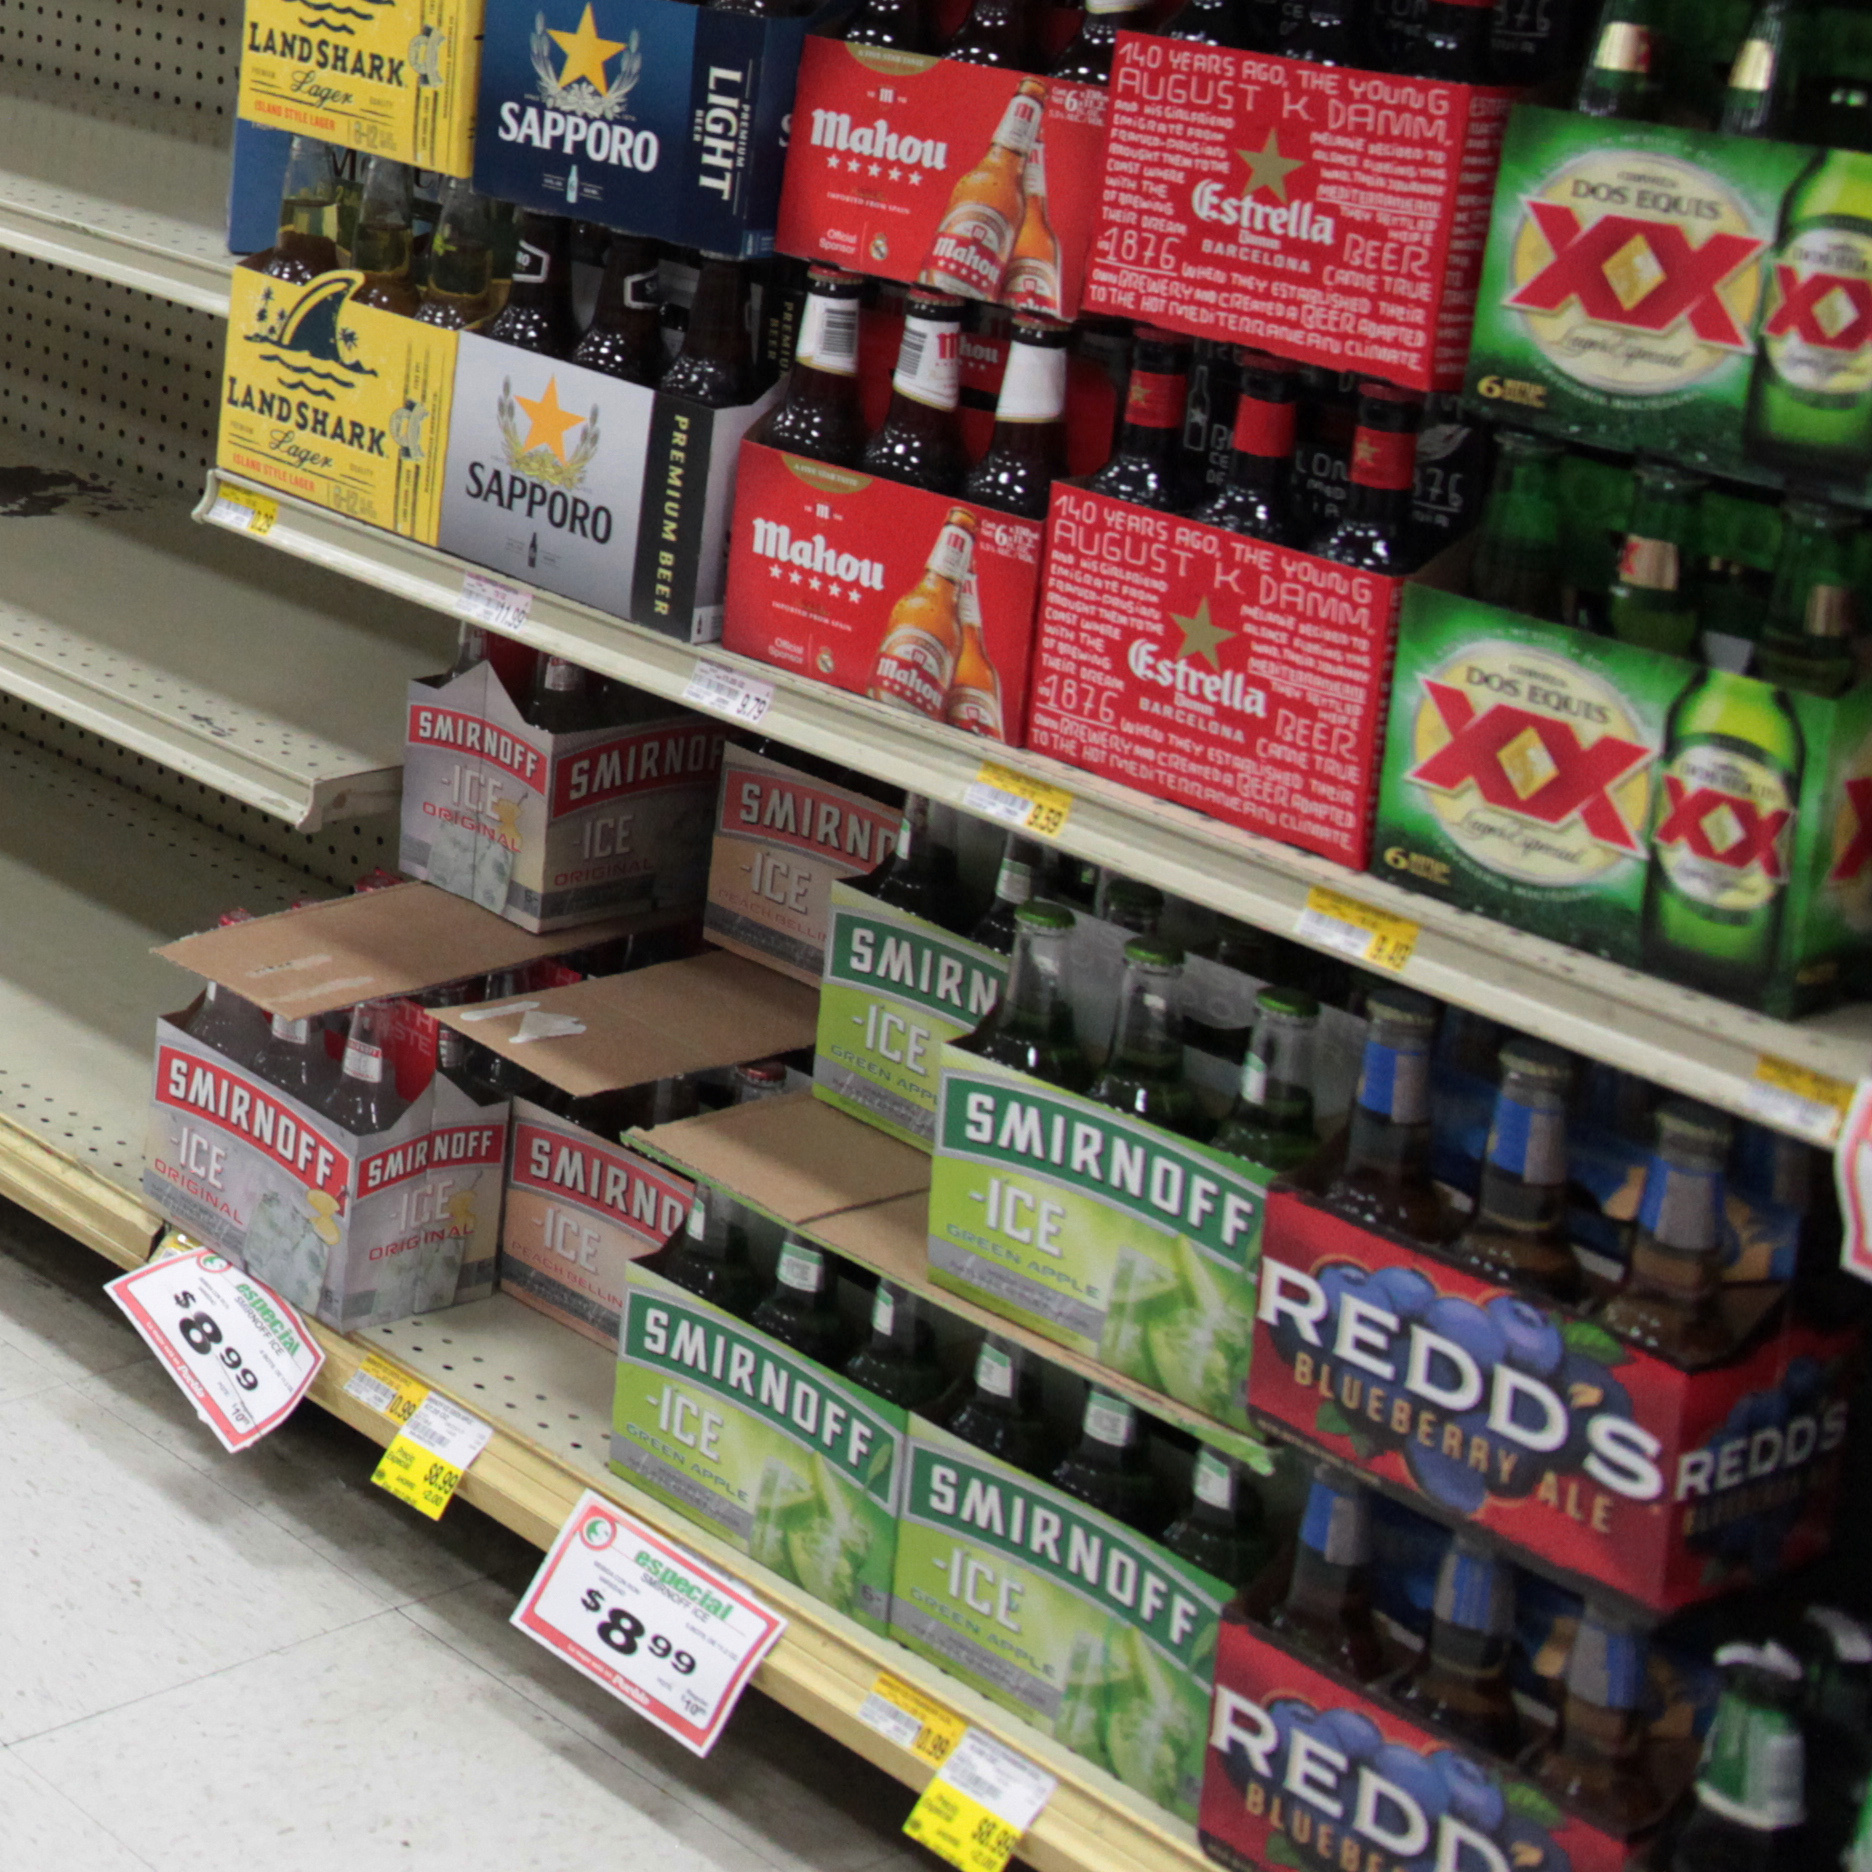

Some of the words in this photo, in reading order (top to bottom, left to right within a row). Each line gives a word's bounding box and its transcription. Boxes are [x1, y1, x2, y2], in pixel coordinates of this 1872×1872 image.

[247, 21, 406, 89] LANDSHARK
[290, 68, 355, 109] Lager
[1116, 66, 1262, 112] AUGUST
[1117, 40, 1163, 70] 140
[1168, 50, 1236, 79] YEARS
[1296, 69, 1342, 96] THE
[1347, 76, 1451, 117] YOUNG
[497, 98, 659, 174] SAPPORO
[697, 64, 743, 201] LIGHT
[736, 103, 752, 169] PREMIUM
[809, 107, 950, 172] Mahou
[1191, 178, 1336, 247] Estrella
[1571, 179, 1630, 205] DOS
[1636, 186, 1723, 222] EQUIS
[932, 236, 1001, 280] Mahou
[1107, 226, 1183, 271] 1876
[1201, 238, 1312, 275] BARCELONA
[1344, 232, 1432, 278] BEER
[226, 375, 387, 458] LANDSHARK
[1476, 374, 1502, 400] 6
[268, 428, 334, 470] Lager
[663, 413, 690, 542] PREMIUM
[464, 458, 614, 547] SAPPORO
[1053, 494, 1098, 525] 140
[1103, 506, 1169, 544] YEARS
[1230, 540, 1274, 571] THE
[752, 517, 886, 591] Mahou
[1052, 519, 1195, 578] AUGUST
[653, 549, 675, 617] BEER
[875, 656, 943, 711] Mahou
[1126, 636, 1268, 719] Estrella
[1464, 665, 1522, 696] DOS
[1526, 680, 1613, 727] EQUIS
[418, 710, 539, 778] SMIRNOFF
[1138, 696, 1246, 746] BARCELONA
[1274, 707, 1360, 761] BEER
[422, 800, 522, 854] ORIGINAL
[553, 858, 655, 887] ORIGINAL
[168, 1057, 335, 1189] SMIRNOFF
[154, 1158, 244, 1227] ORIGINAL
[368, 1130, 494, 1189] SMIRNOFF
[965, 1091, 1254, 1251] SMIRNOFF
[368, 1224, 476, 1262] ORIGINAL
[946, 1222, 1024, 1266] GREEN
[1027, 1254, 1101, 1302] APPLE
[236, 1283, 301, 1357] especial
[642, 1307, 873, 1468] SMIRNOFF
[1256, 1254, 1666, 1500] REDD'S
[625, 1421, 692, 1467] GREEN
[694, 1455, 750, 1504] APPLE
[1292, 1351, 1519, 1487] BLUEBERRY
[1536, 1468, 1614, 1535] ALE
[635, 1549, 735, 1623] especial
[928, 1463, 1198, 1649] SMIRNOFF
[909, 1583, 976, 1636] GREEN
[980, 1622, 1057, 1681] APPLE
